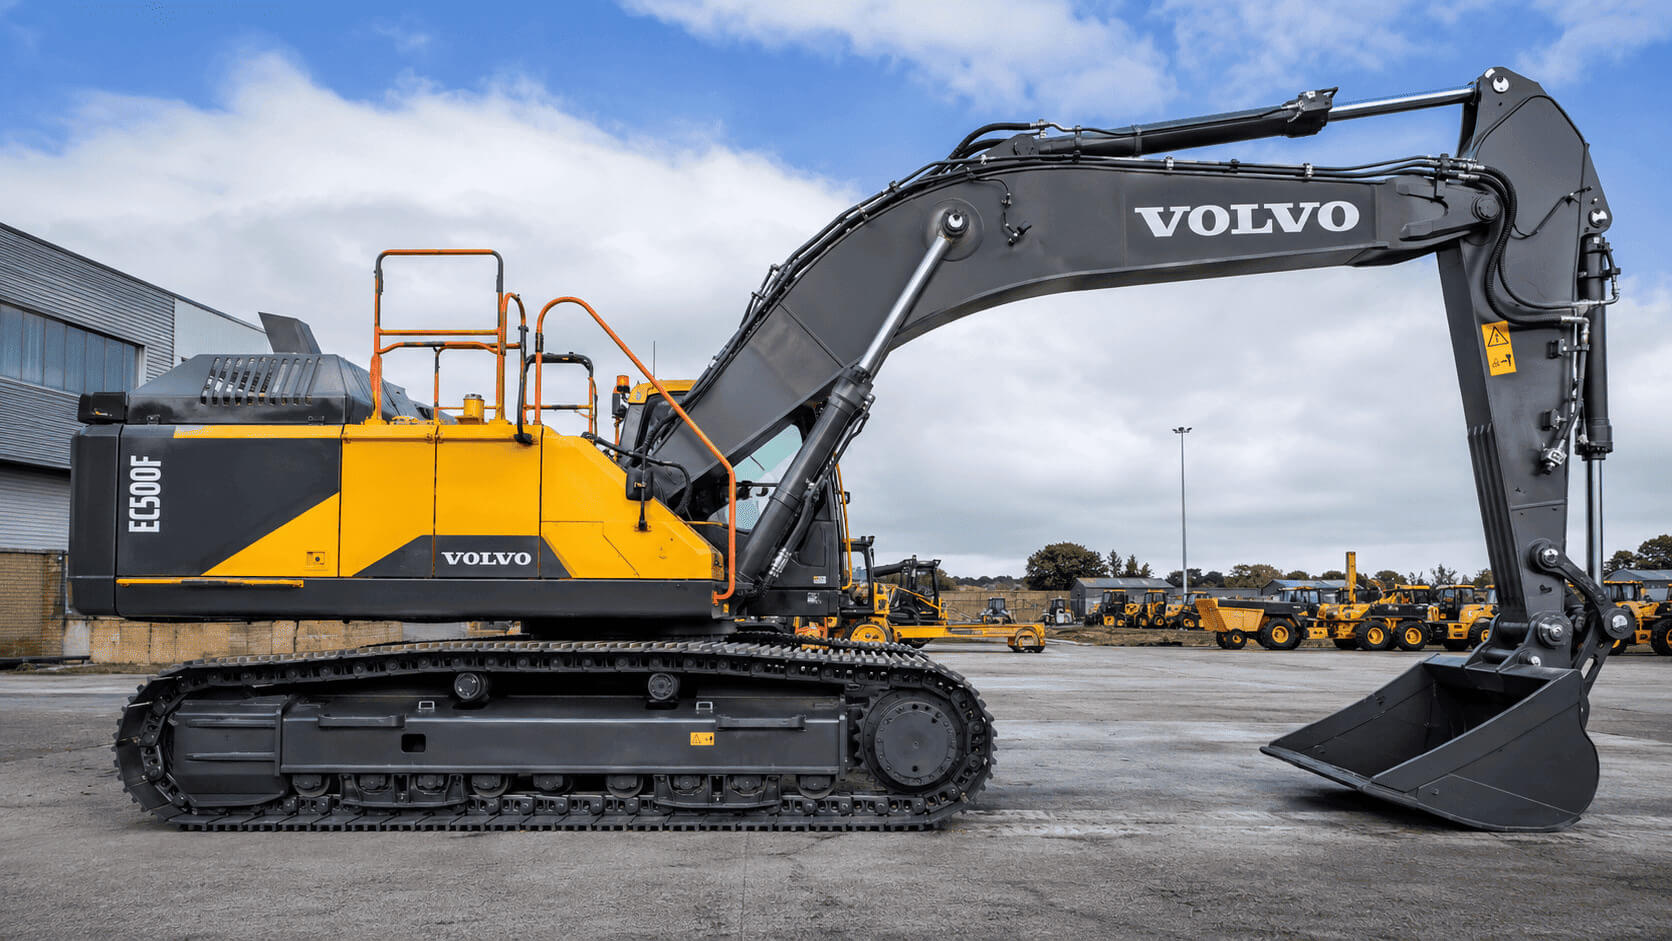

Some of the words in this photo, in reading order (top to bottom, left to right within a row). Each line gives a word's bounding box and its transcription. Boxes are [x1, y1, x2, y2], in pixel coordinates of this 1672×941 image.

[1134, 200, 1360, 237] VOLVO
[128, 455, 162, 533] EC500F
[441, 551, 532, 566] VOLVO
